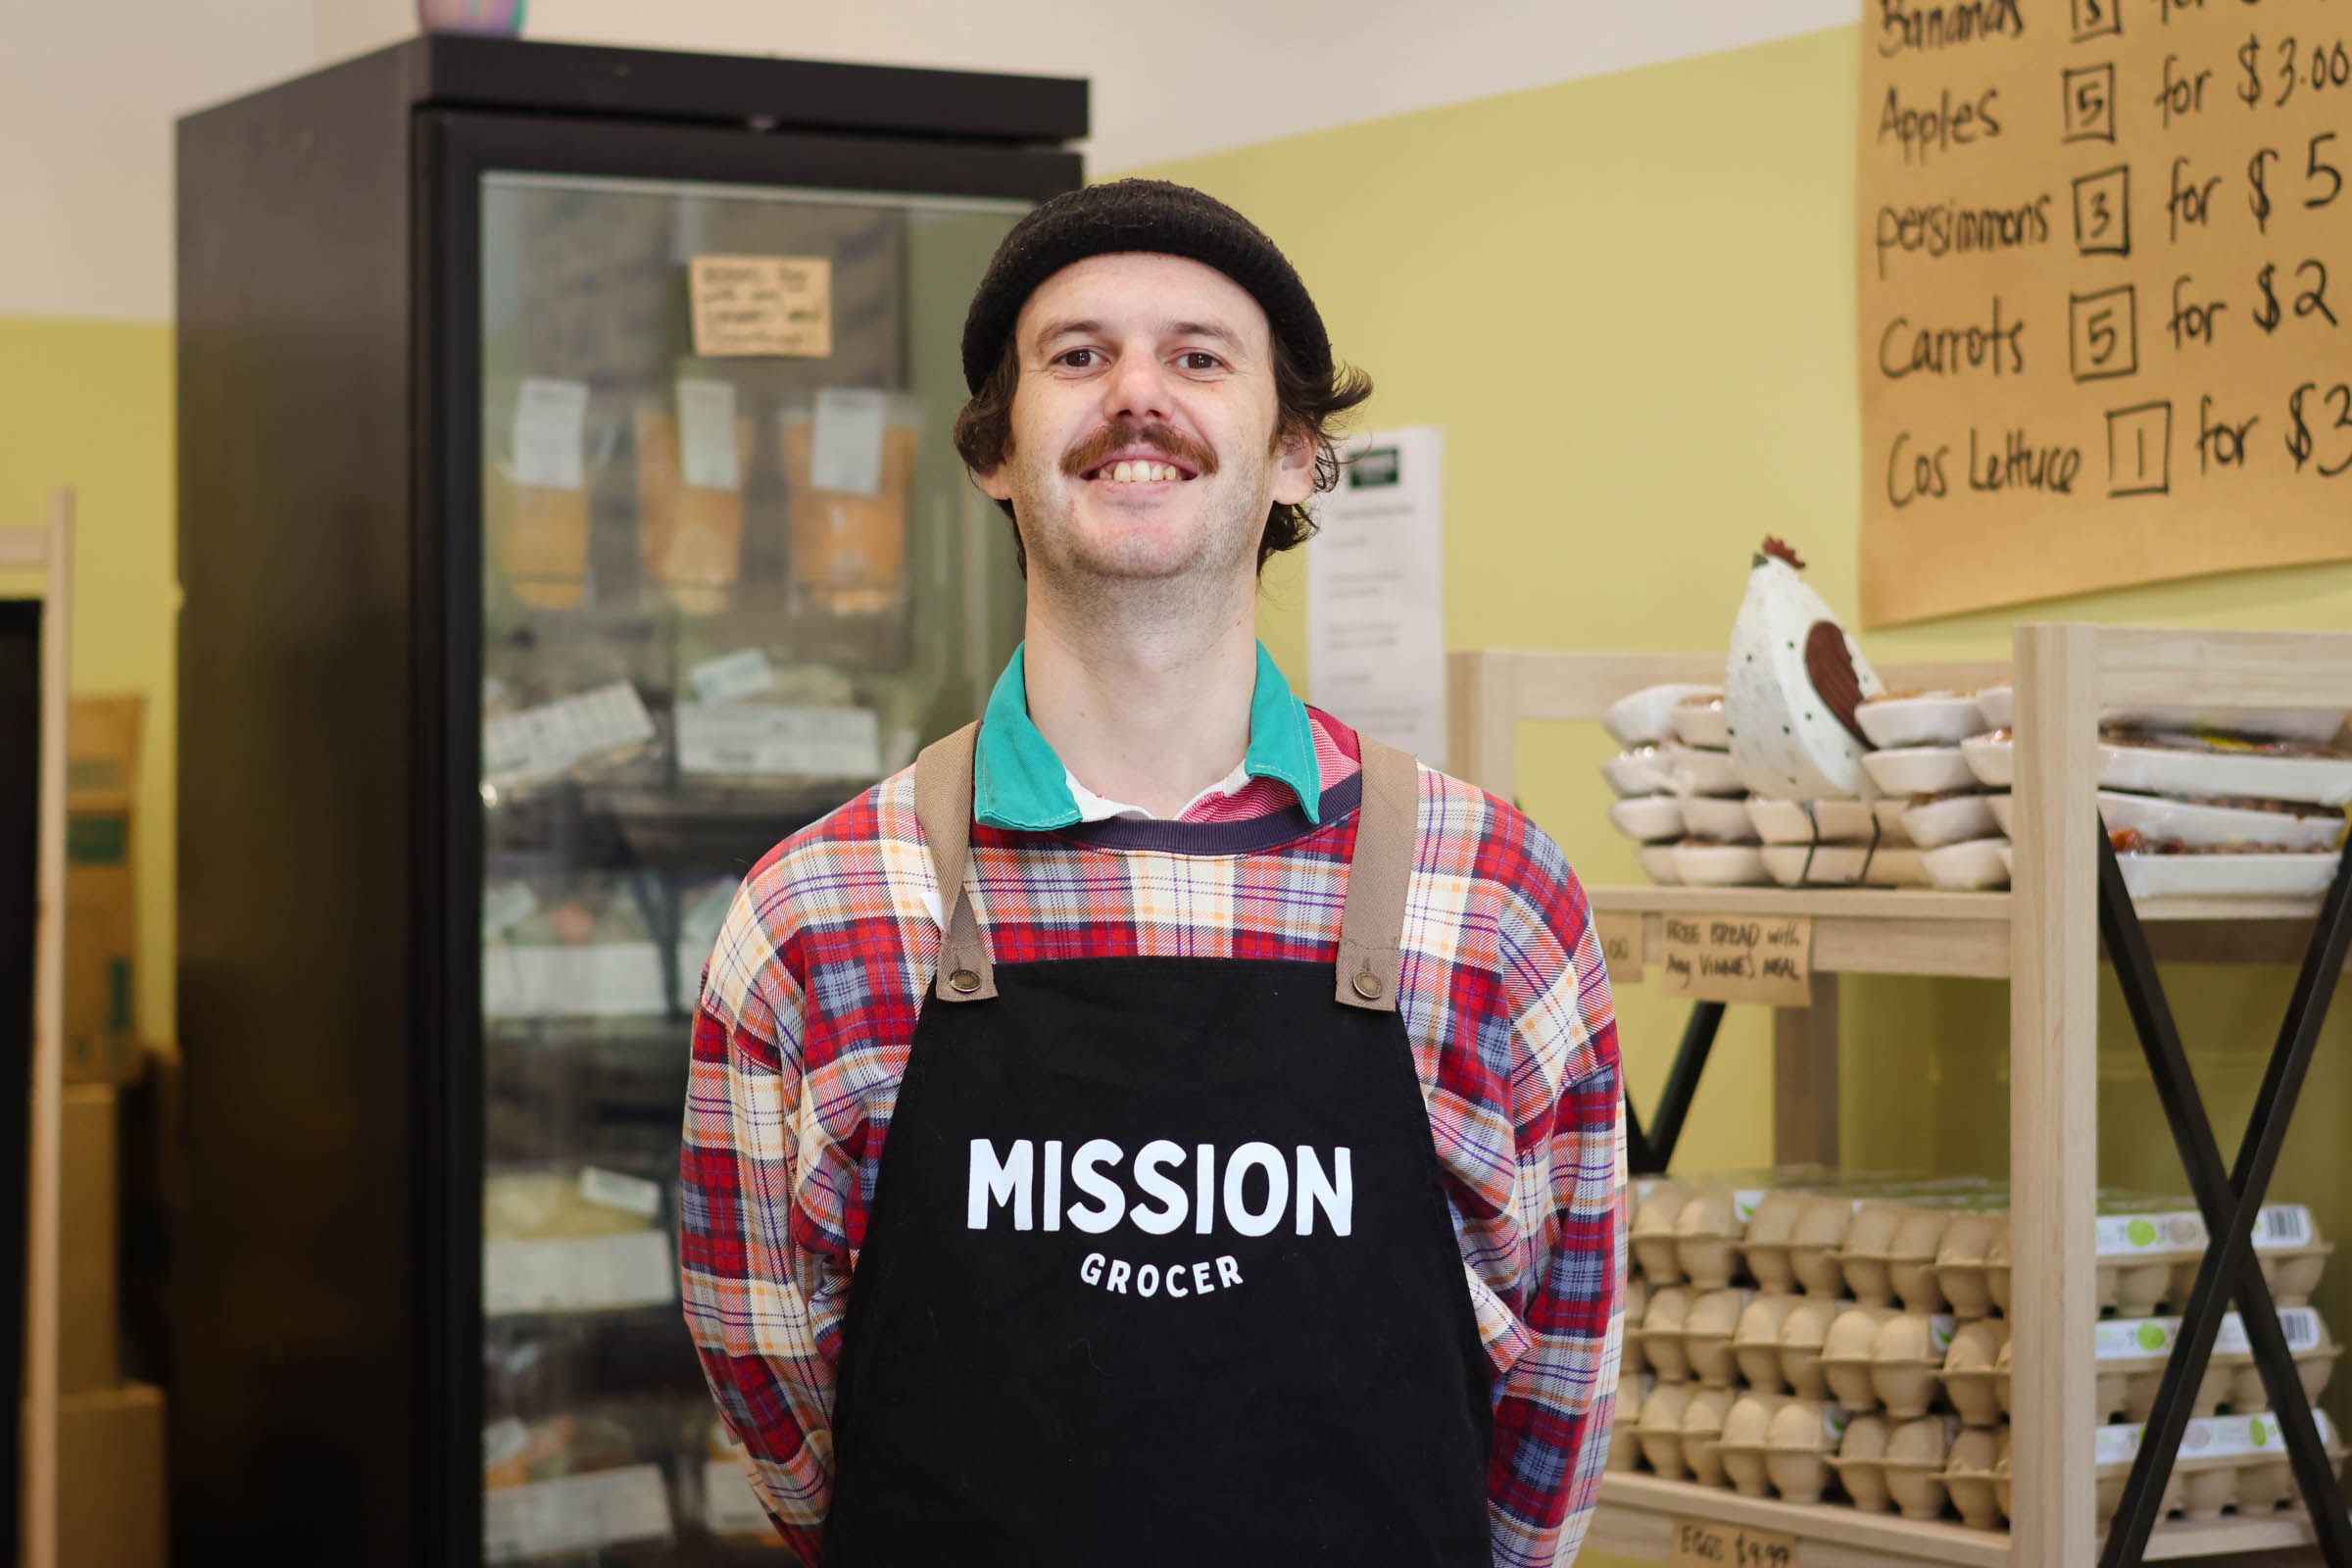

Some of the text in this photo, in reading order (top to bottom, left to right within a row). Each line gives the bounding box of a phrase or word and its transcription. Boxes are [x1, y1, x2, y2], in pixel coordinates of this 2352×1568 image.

[1879, 0, 2026, 58] Bananas
[1879, 32, 2352, 165] Apples 5 for $3.00
[1876, 193, 2052, 279] persimmons
[2090, 190, 2112, 239] 3
[2165, 156, 2223, 244] for
[1879, 258, 2339, 380] Carrots 5 for $2
[1886, 432, 1949, 510] Cos
[1968, 427, 2082, 496] Lettuce
[2195, 393, 2260, 475] for
[967, 1139, 1352, 1237] MISSION
[1081, 1253, 1243, 1298] GROCER
